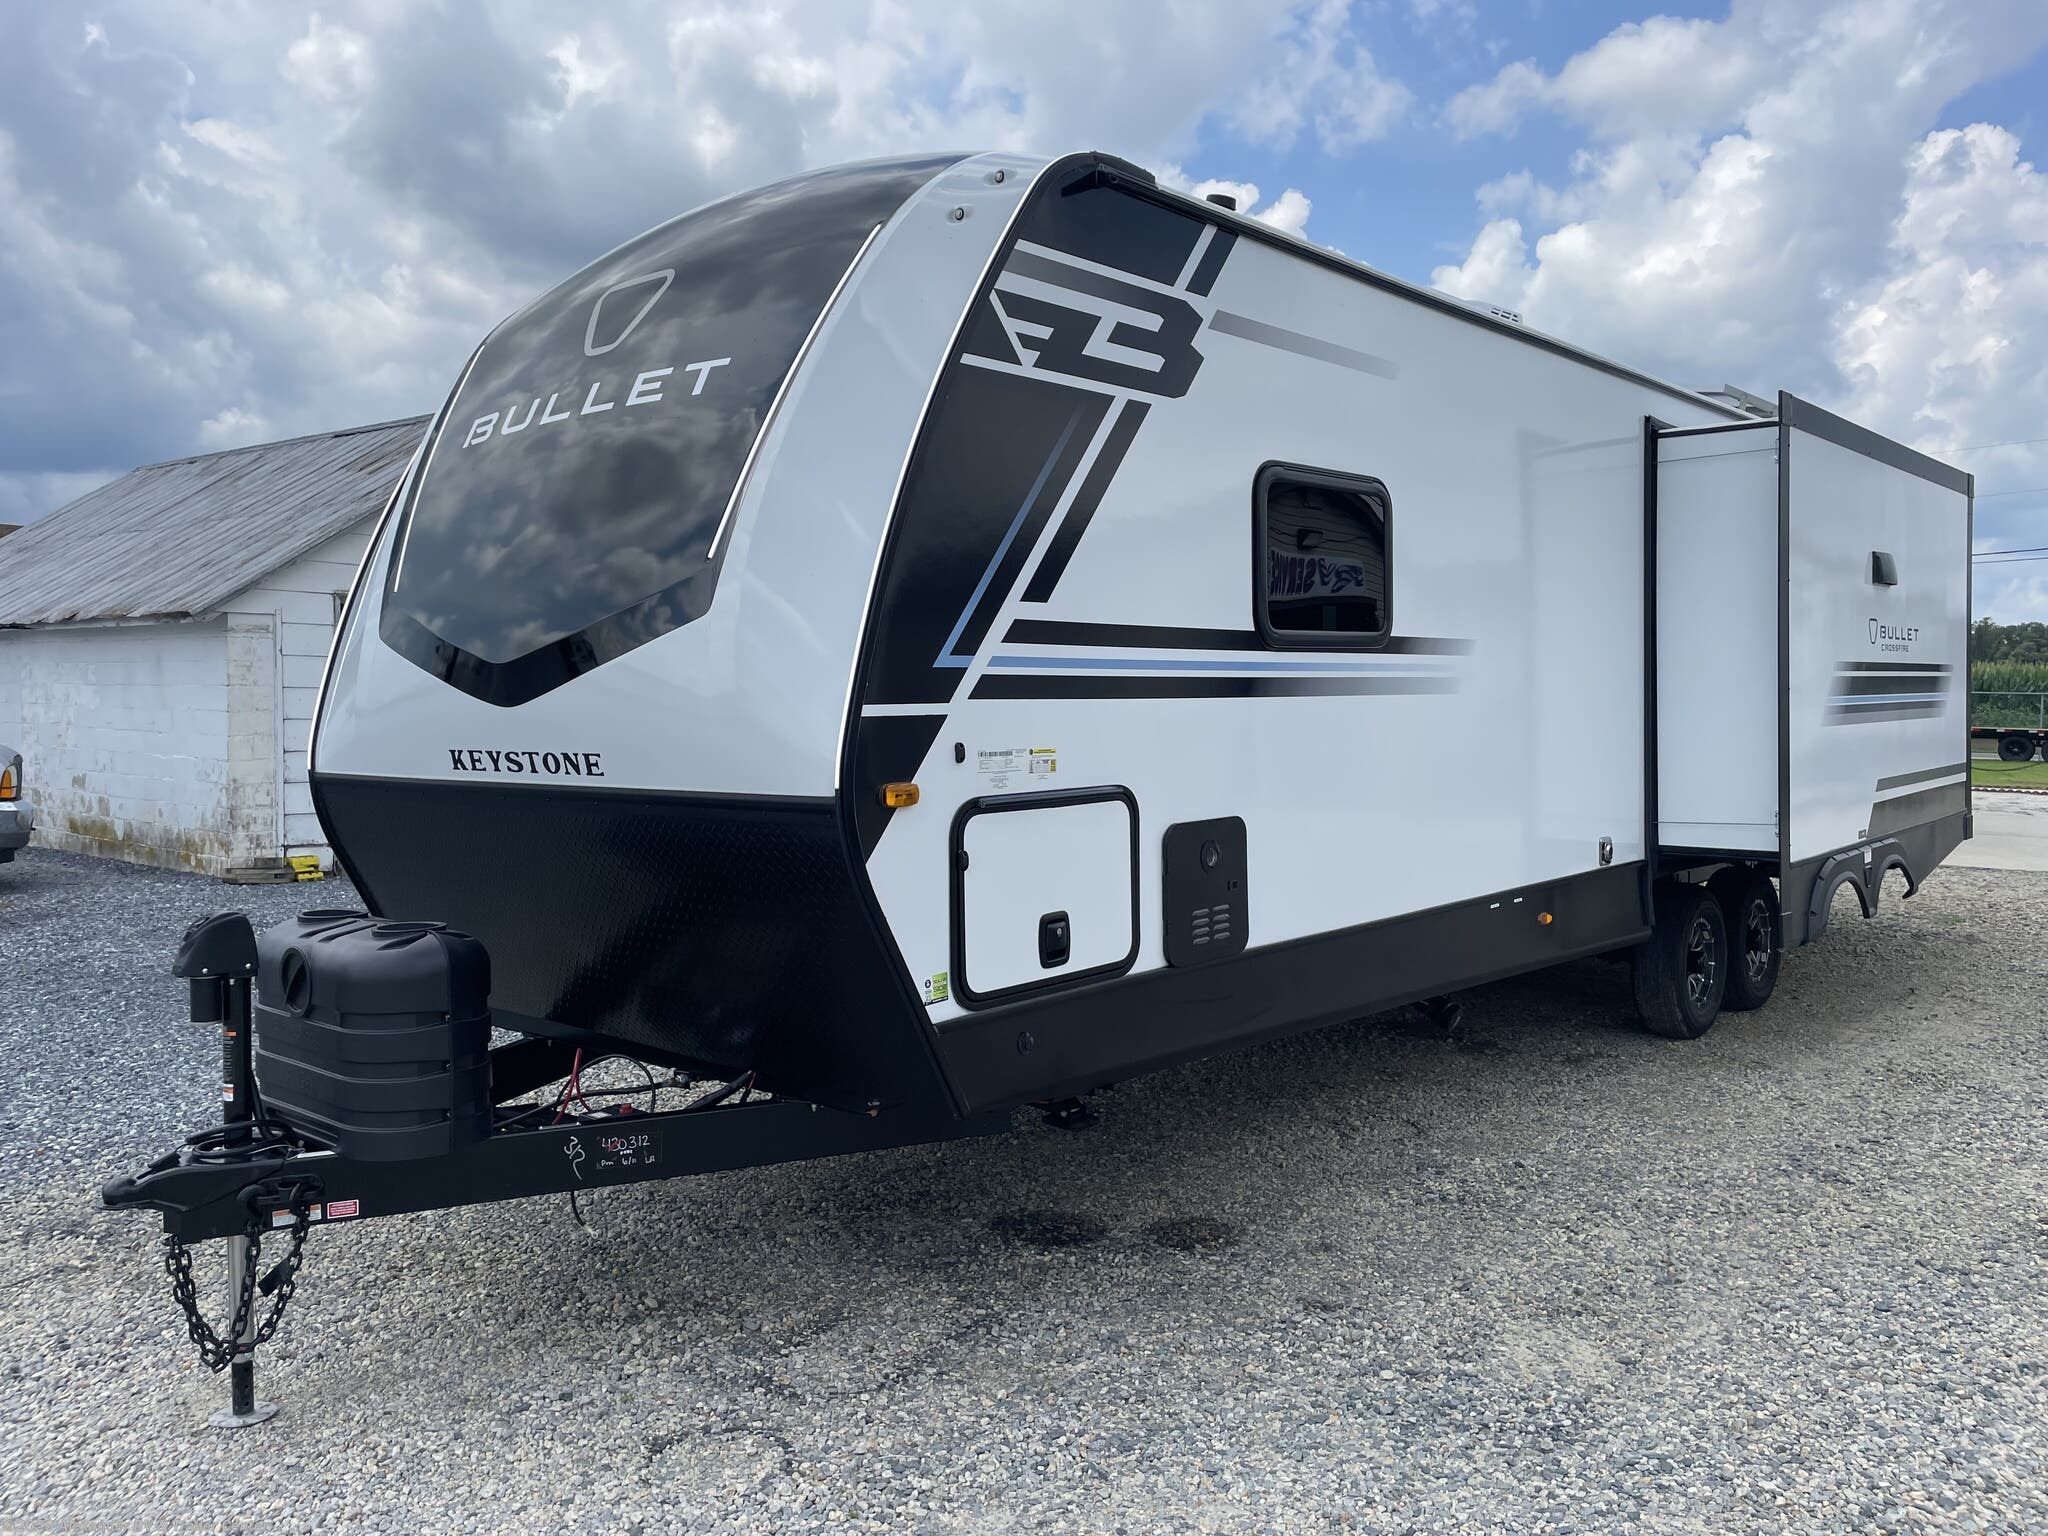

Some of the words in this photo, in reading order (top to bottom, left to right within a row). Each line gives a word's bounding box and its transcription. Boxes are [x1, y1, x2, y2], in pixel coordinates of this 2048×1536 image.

[463, 357, 732, 449] BULLET
[1880, 625, 1919, 641] BULLET
[1881, 643, 1909, 652] CROSSFIRE
[448, 749, 605, 777] KEYSTONE
